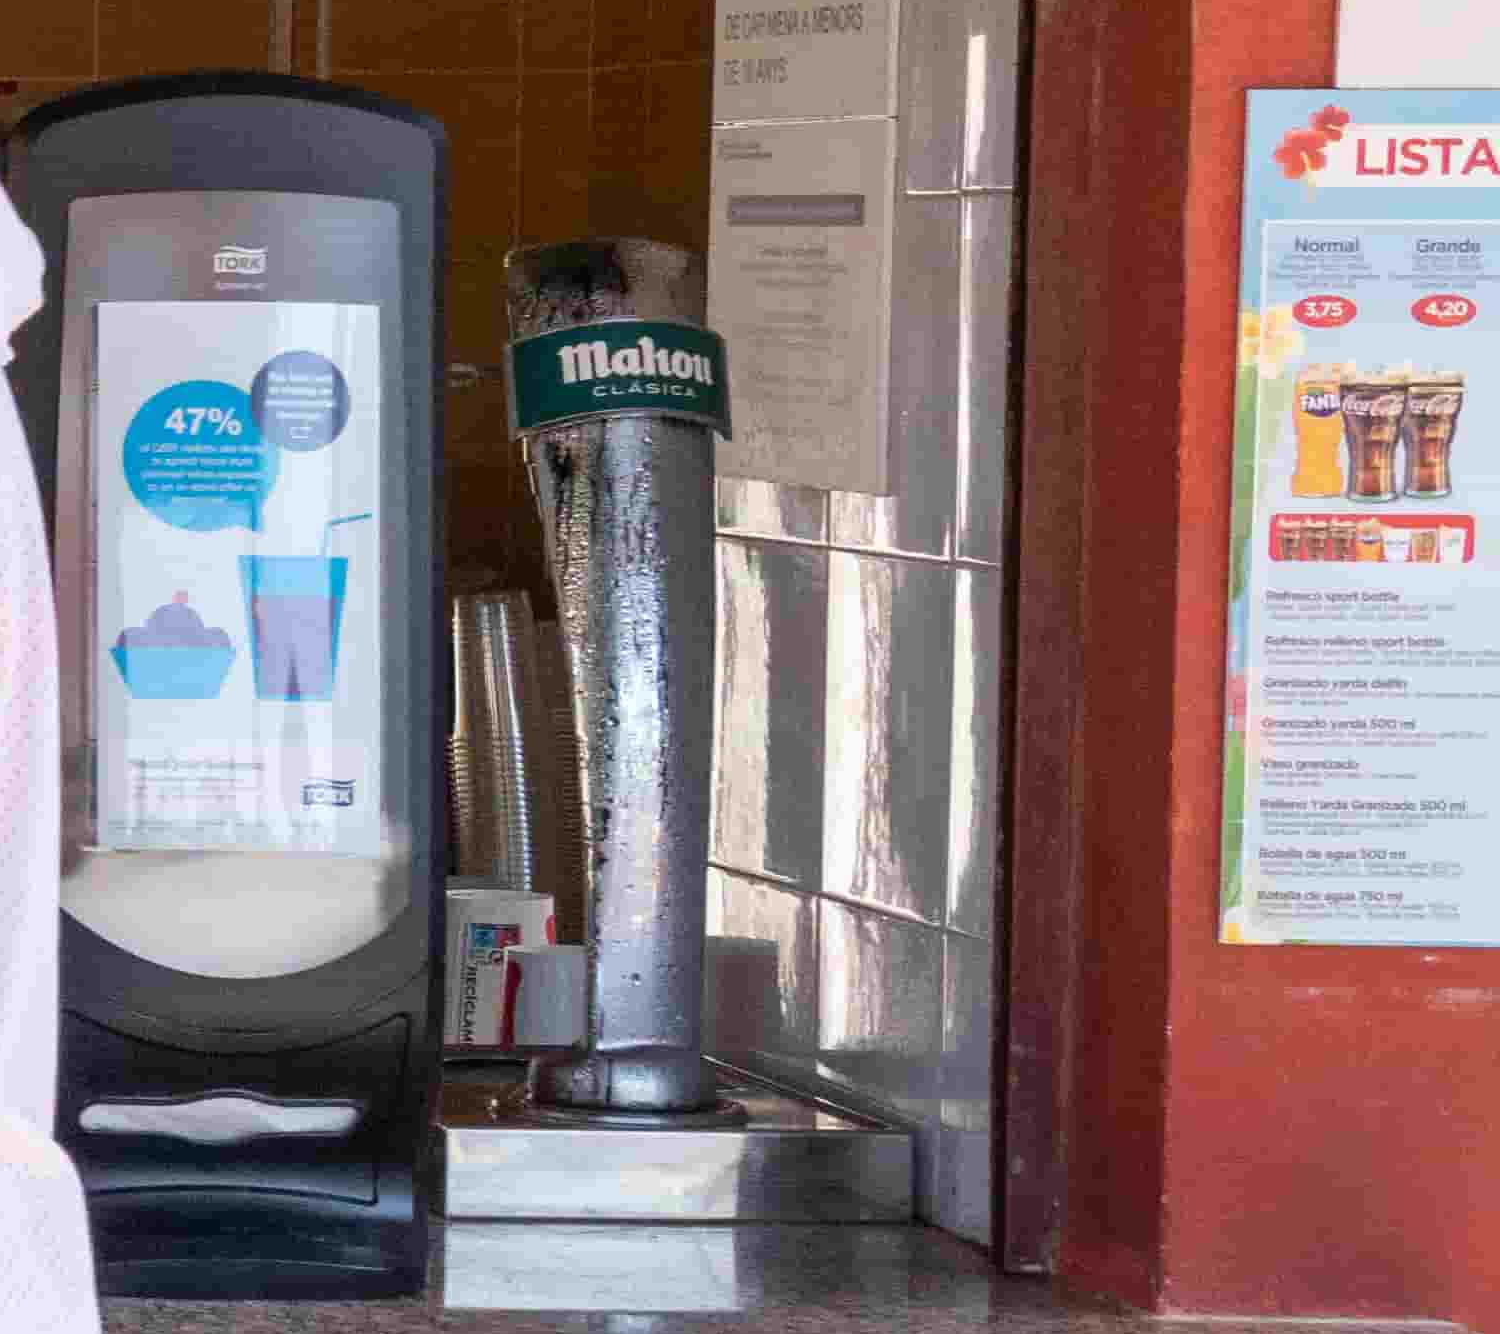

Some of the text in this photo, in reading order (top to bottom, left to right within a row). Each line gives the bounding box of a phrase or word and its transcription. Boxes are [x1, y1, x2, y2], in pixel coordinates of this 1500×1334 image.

[1356, 138, 1500, 175] LISTA
[1295, 238, 1359, 252] Normal
[1417, 239, 1480, 253] Grande
[1305, 302, 1343, 318] 3,75
[1425, 301, 1468, 319] 4,20
[557, 336, 714, 385] Mahou
[164, 408, 242, 435] 47%
